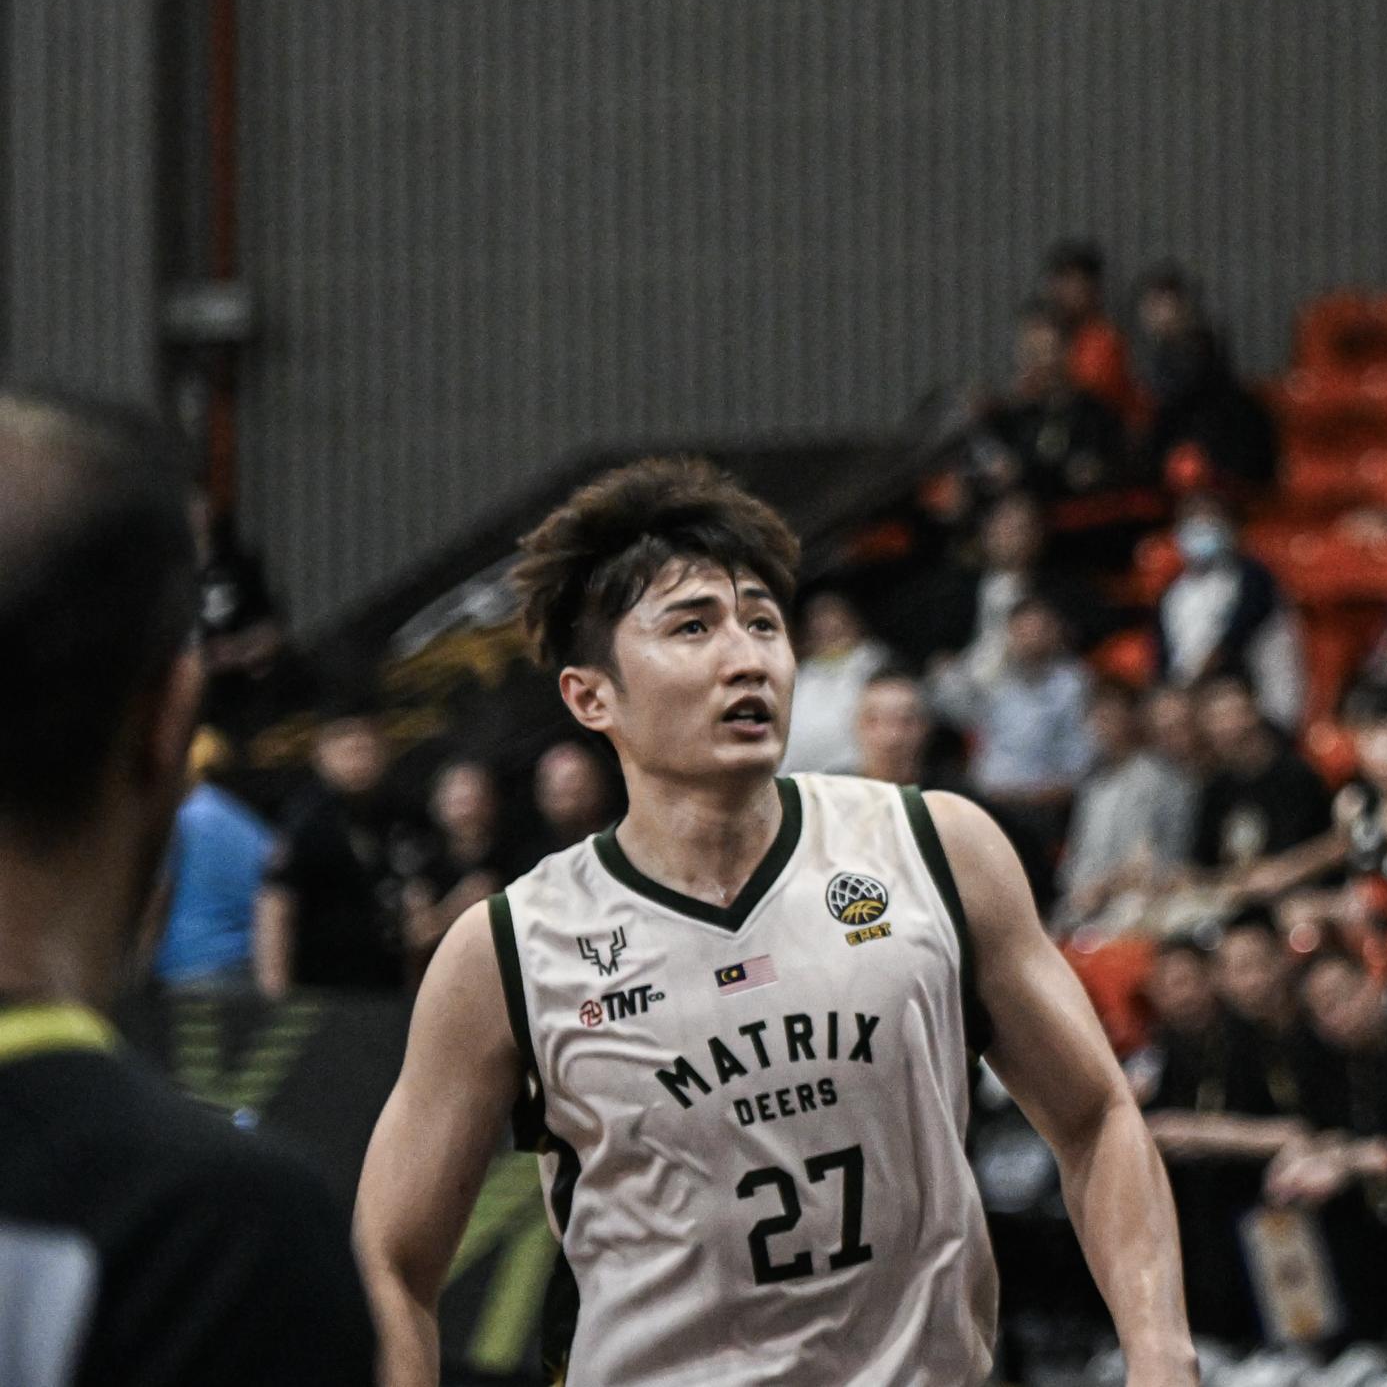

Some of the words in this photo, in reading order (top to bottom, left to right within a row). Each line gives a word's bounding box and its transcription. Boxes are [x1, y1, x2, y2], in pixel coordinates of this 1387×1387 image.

[844, 921, 892, 947] EAST
[655, 1011, 880, 1109] MATRIX
[733, 1077, 838, 1127] DEERS
[735, 1144, 873, 1287] 27
